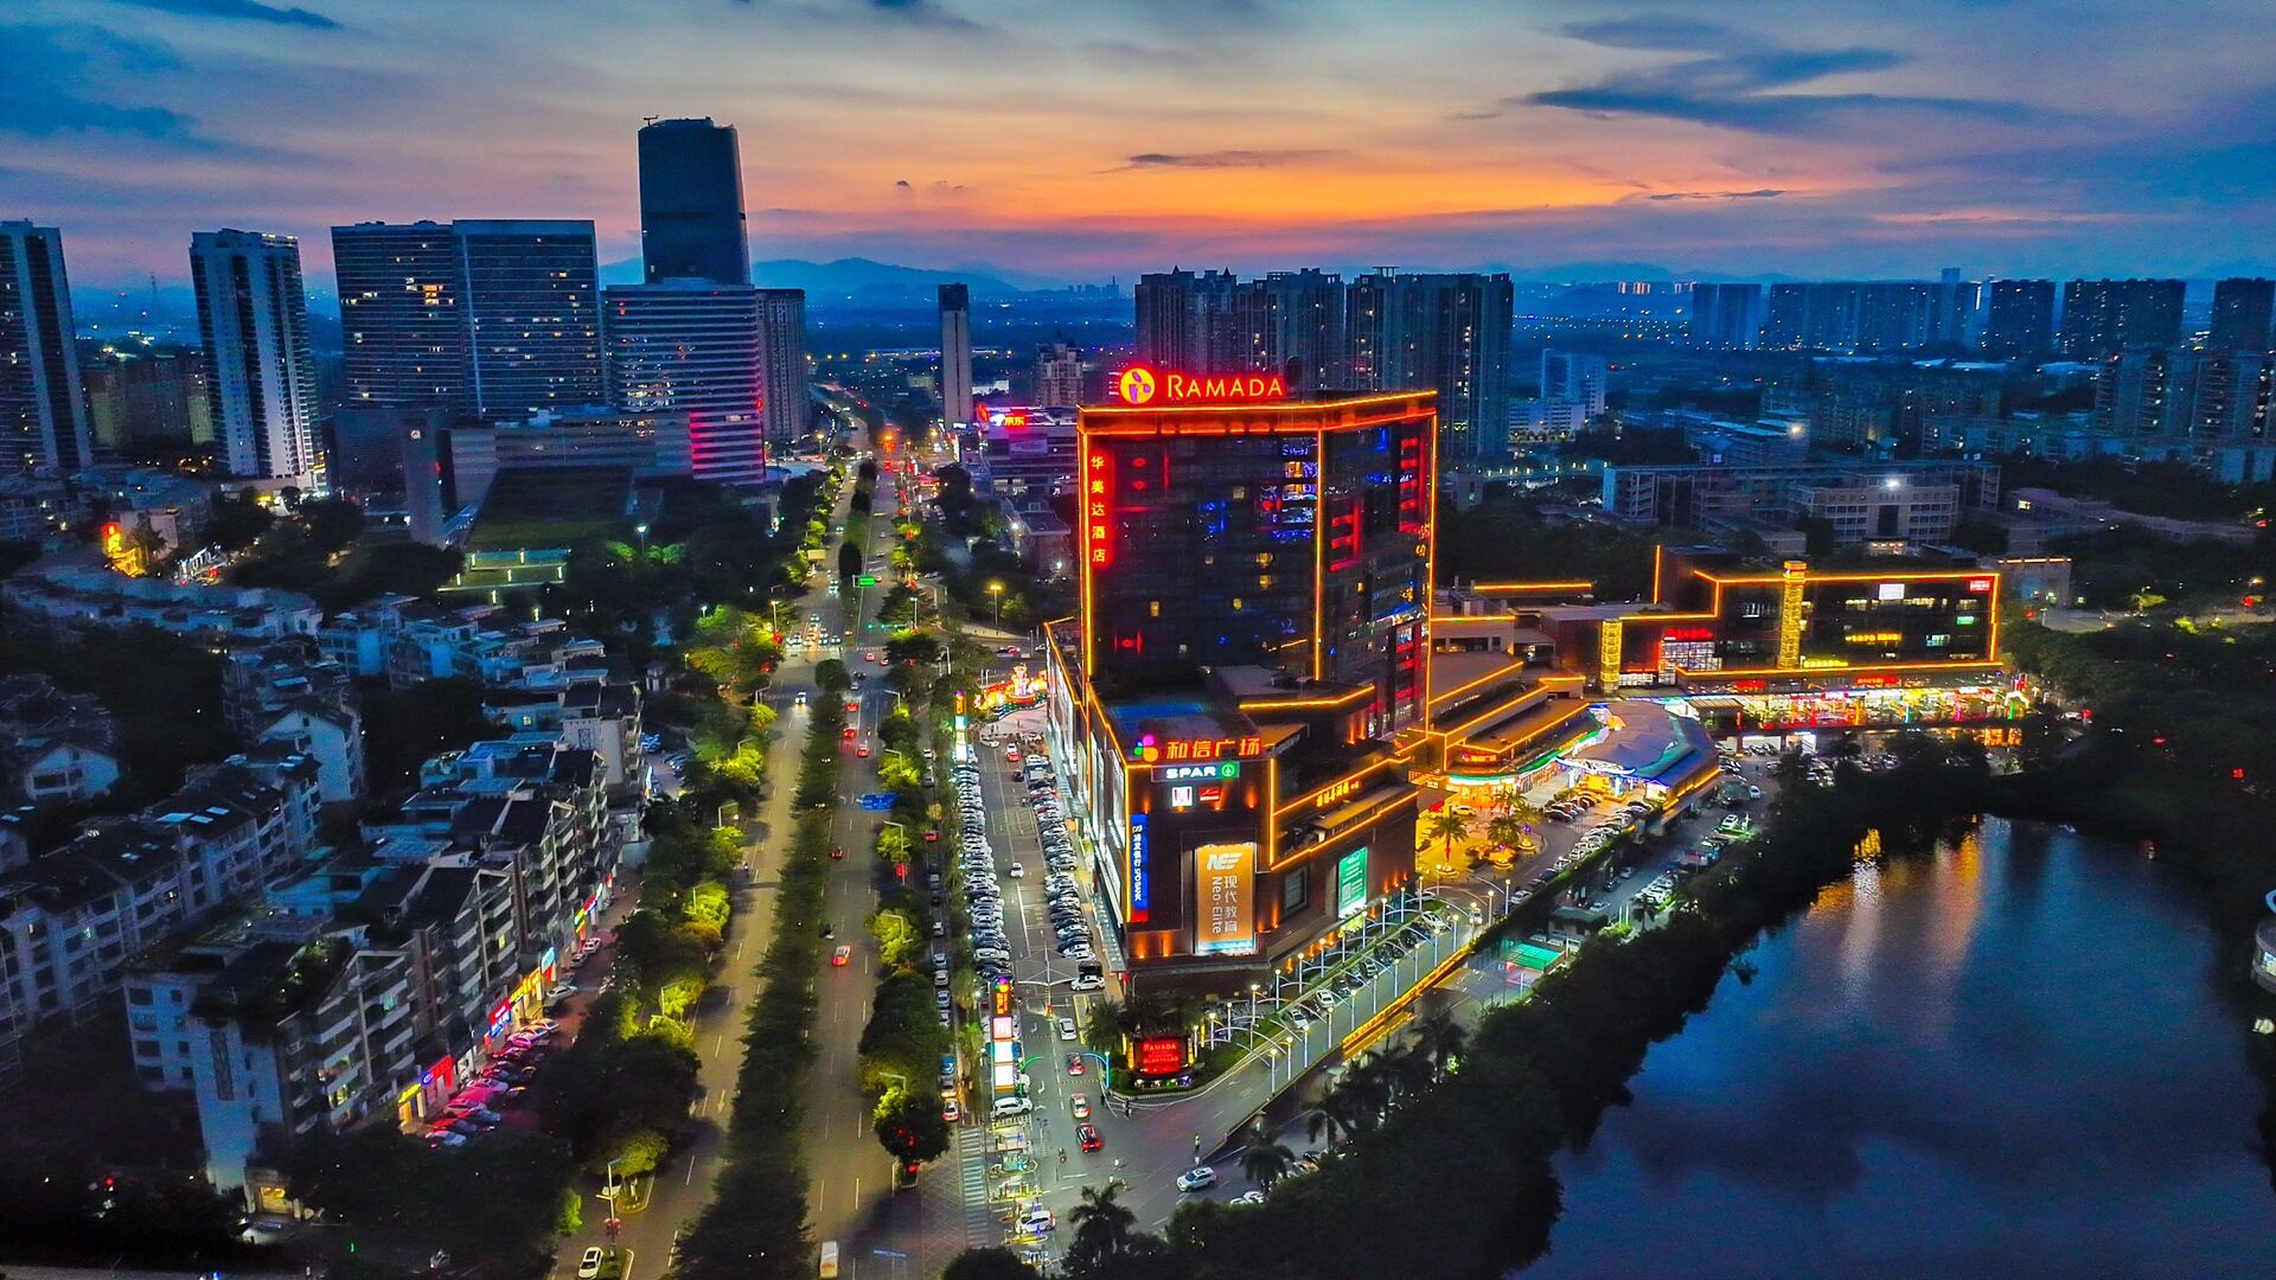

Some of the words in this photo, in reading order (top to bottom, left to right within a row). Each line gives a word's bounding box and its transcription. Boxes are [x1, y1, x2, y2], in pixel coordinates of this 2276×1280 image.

[1168, 375, 1283, 398] RAMADA
[1005, 416, 1025, 427] 京东
[1090, 455, 1106, 563] 华美达酒店
[1166, 737, 1261, 760] 和信广场
[1165, 766, 1217, 779] SPAR
[1224, 875, 1238, 932] 现代教育
[1143, 1043, 1176, 1051] RAMADA
